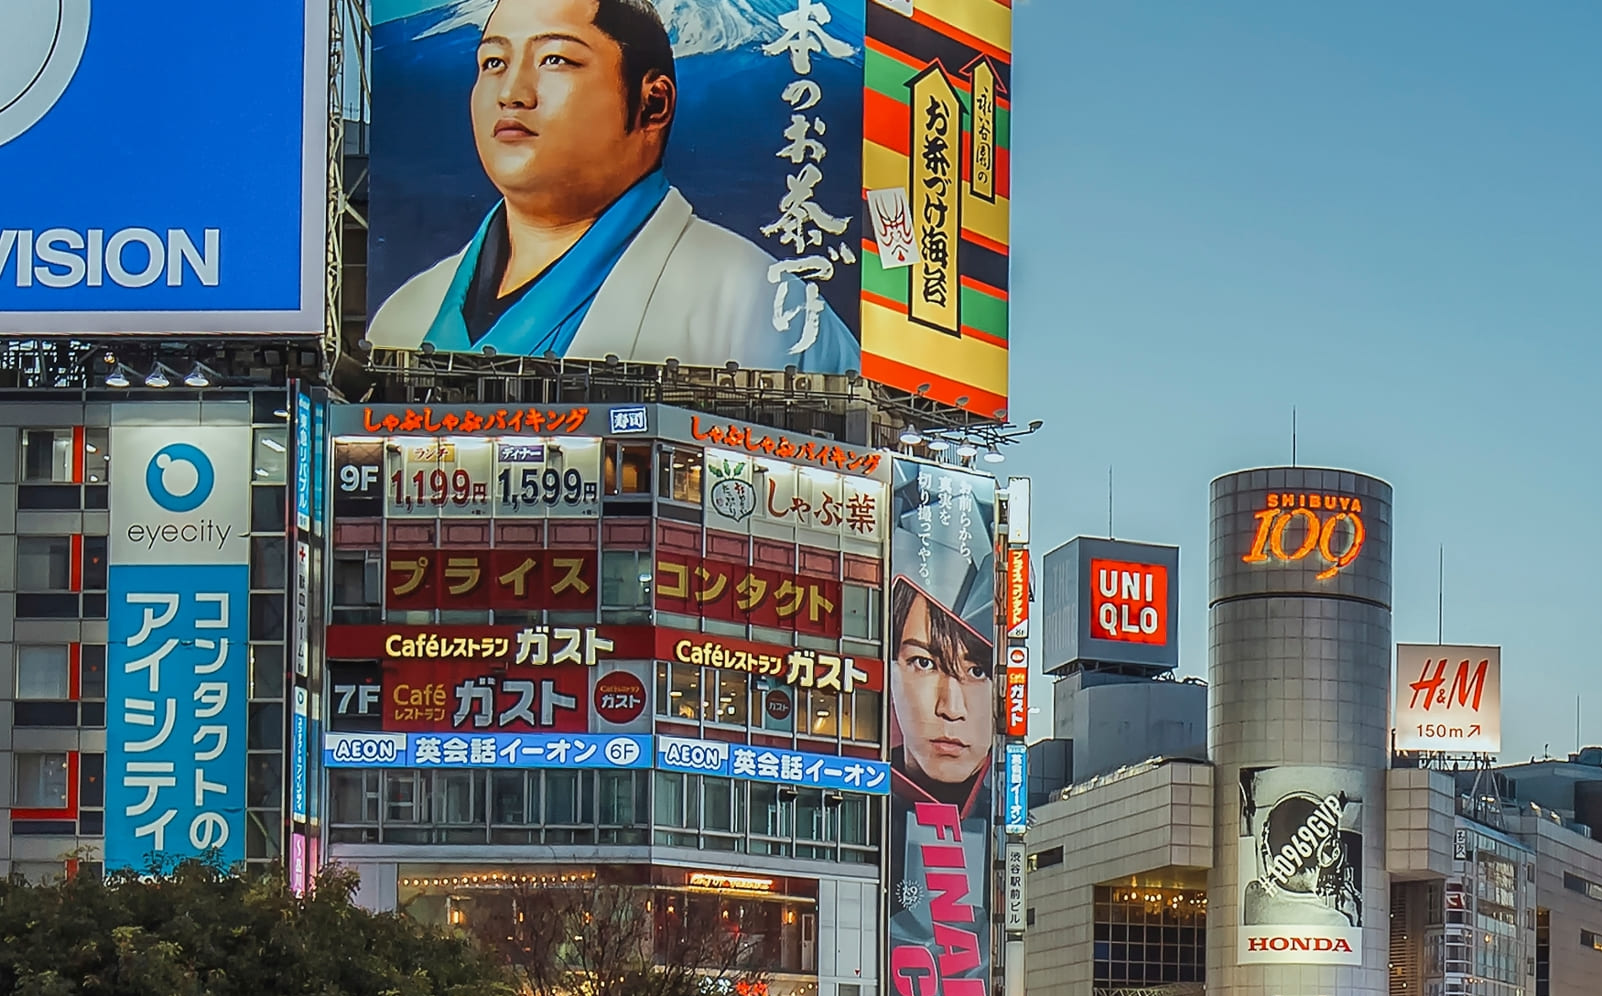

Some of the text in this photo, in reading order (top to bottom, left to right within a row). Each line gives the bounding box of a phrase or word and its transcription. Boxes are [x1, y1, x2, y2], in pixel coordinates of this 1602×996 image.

[976, 87, 993, 185] 永谷園の
[922, 95, 951, 308] お茶づけ海苔
[363, 407, 589, 433] しゃぶしゃぶバイキング
[614, 411, 645, 429] 寿司
[413, 447, 450, 461] ランチ
[501, 445, 542, 461] ディナー
[690, 415, 882, 475] しゃぶしゃぶバイキング
[340, 465, 379, 492] 9F
[391, 468, 488, 512] 1,199円
[498, 468, 598, 512] 1,599円
[767, 477, 876, 534] しゃぶ葉
[1267, 493, 1363, 513] SHIBUYA
[128, 519, 232, 549] eyecity
[1241, 507, 1366, 581] 109
[390, 556, 591, 596] プライス
[657, 560, 835, 622] コンタクト
[1099, 569, 1153, 602] UNI
[1099, 602, 1158, 636] QLO
[385, 625, 614, 666] Caféレストラン ガスト
[675, 639, 868, 693] Caféレストラン ガスト
[334, 684, 381, 714] 7F
[392, 677, 577, 728] Café ガスト
[601, 694, 641, 709] ガスト
[1010, 684, 1024, 727] ガスト
[1409, 657, 1490, 713] H&M
[123, 592, 180, 850] アイシティ
[189, 592, 229, 849] コンタクトの
[395, 708, 446, 721] レストラン
[1416, 723, 1464, 738] 150m
[333, 736, 635, 764] AEON 英会話イーオン 6F
[664, 744, 886, 789] AEON 英会話イーオン
[1010, 754, 1023, 824] 英会話イーオン
[1009, 851, 1021, 925] 渋谷駅前ビル
[1248, 937, 1352, 953] HONDA
